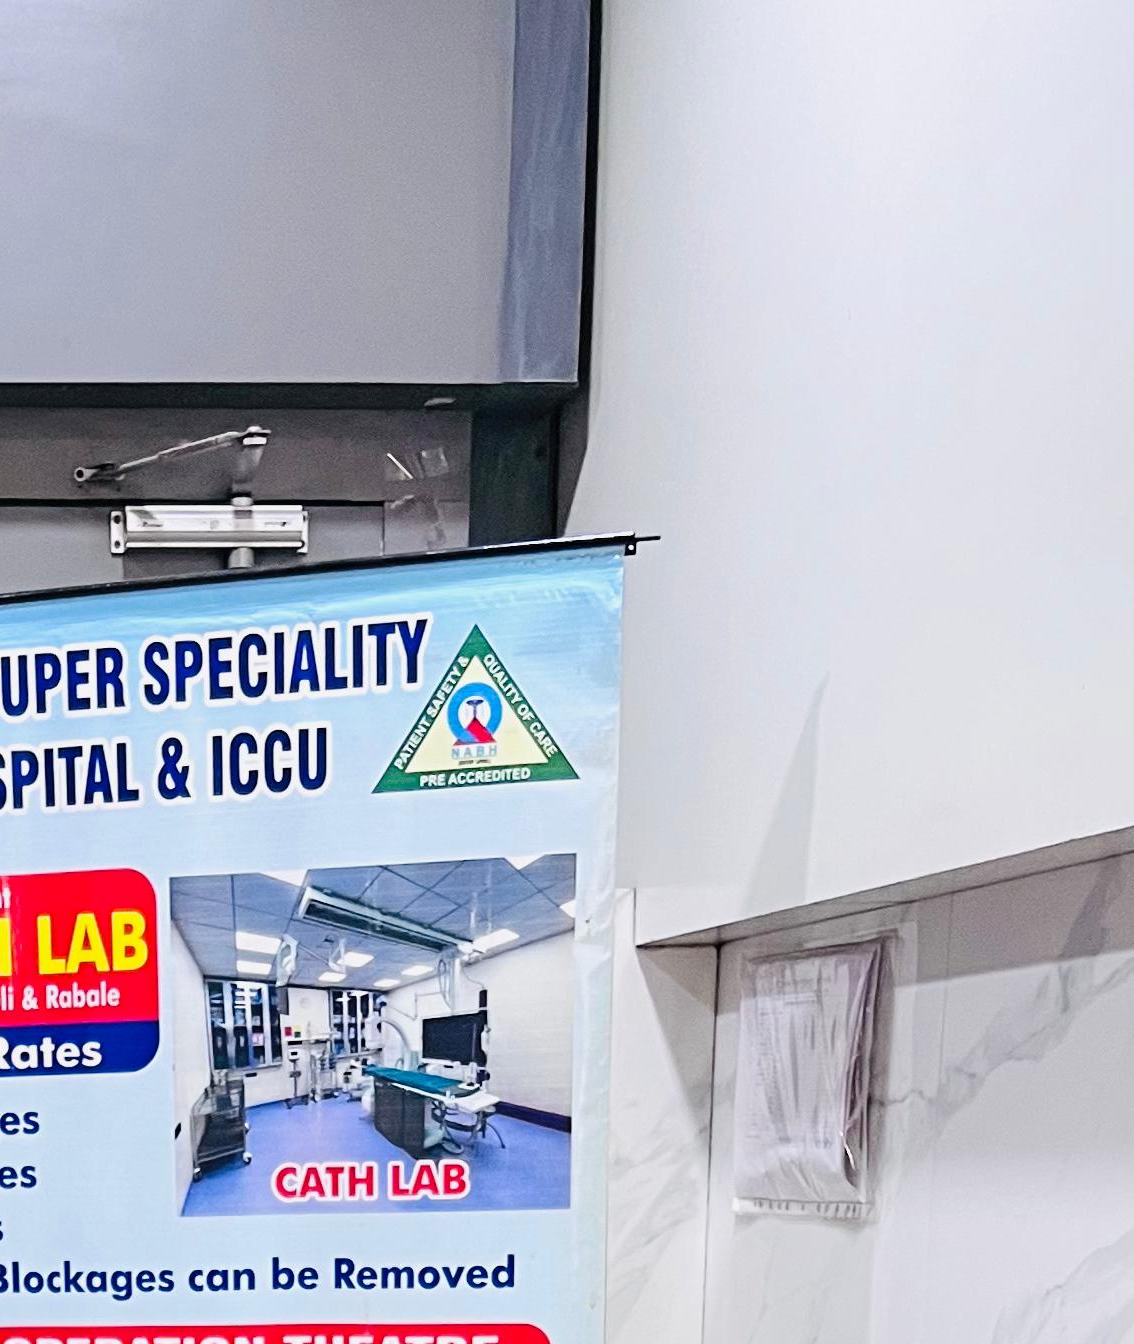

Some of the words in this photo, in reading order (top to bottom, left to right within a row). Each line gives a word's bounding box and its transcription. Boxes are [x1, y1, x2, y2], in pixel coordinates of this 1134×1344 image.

[143, 619, 427, 705] SPECIALITY
[394, 714, 434, 770] PATIENT
[427, 666, 465, 718] SAFETY
[483, 654, 521, 705] QUALITY
[529, 719, 558, 757] CARE
[158, 737, 191, 798] &
[212, 728, 327, 796] ICCU
[420, 774, 445, 787] PRE
[448, 768, 530, 785] ACCREDITED
[36, 912, 148, 975] LAB
[22, 986, 39, 1010] &
[46, 982, 121, 1010] Rabale
[273, 1165, 377, 1201] CATH
[388, 1162, 470, 1197] LAB
[188, 1266, 258, 1291] can
[271, 1258, 320, 1290] be
[334, 1254, 516, 1290] Removed
